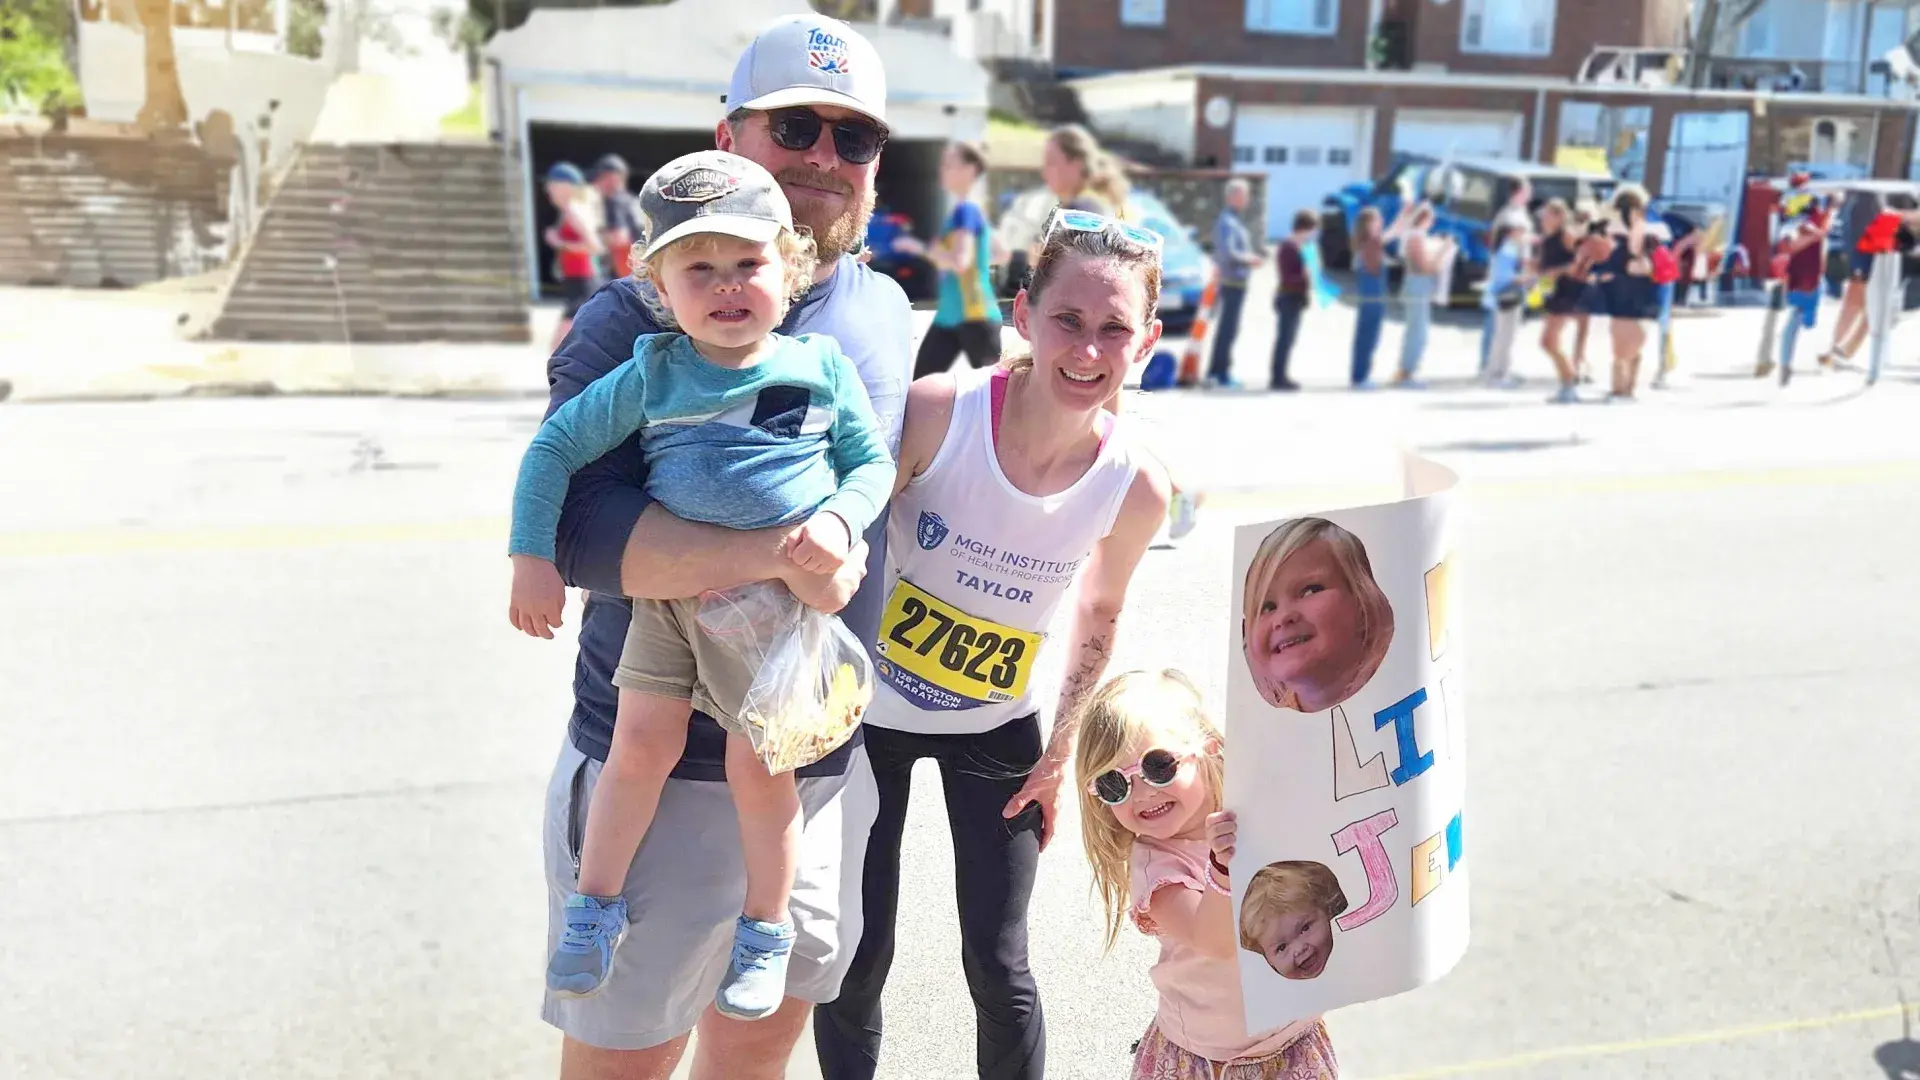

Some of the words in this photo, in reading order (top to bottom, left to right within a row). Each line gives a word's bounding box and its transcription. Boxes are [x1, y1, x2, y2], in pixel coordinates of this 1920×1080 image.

[808, 27, 847, 50] Team
[950, 548, 965, 561] OF
[968, 556, 1009, 575] HEALTH
[955, 534, 996, 558] MGH
[1001, 551, 1079, 574] INSTITUTE
[956, 570, 1034, 604] TAYLOR
[889, 597, 1026, 689] 27623
[895, 677, 959, 709] MARATHON
[919, 682, 962, 704] BOSTON
